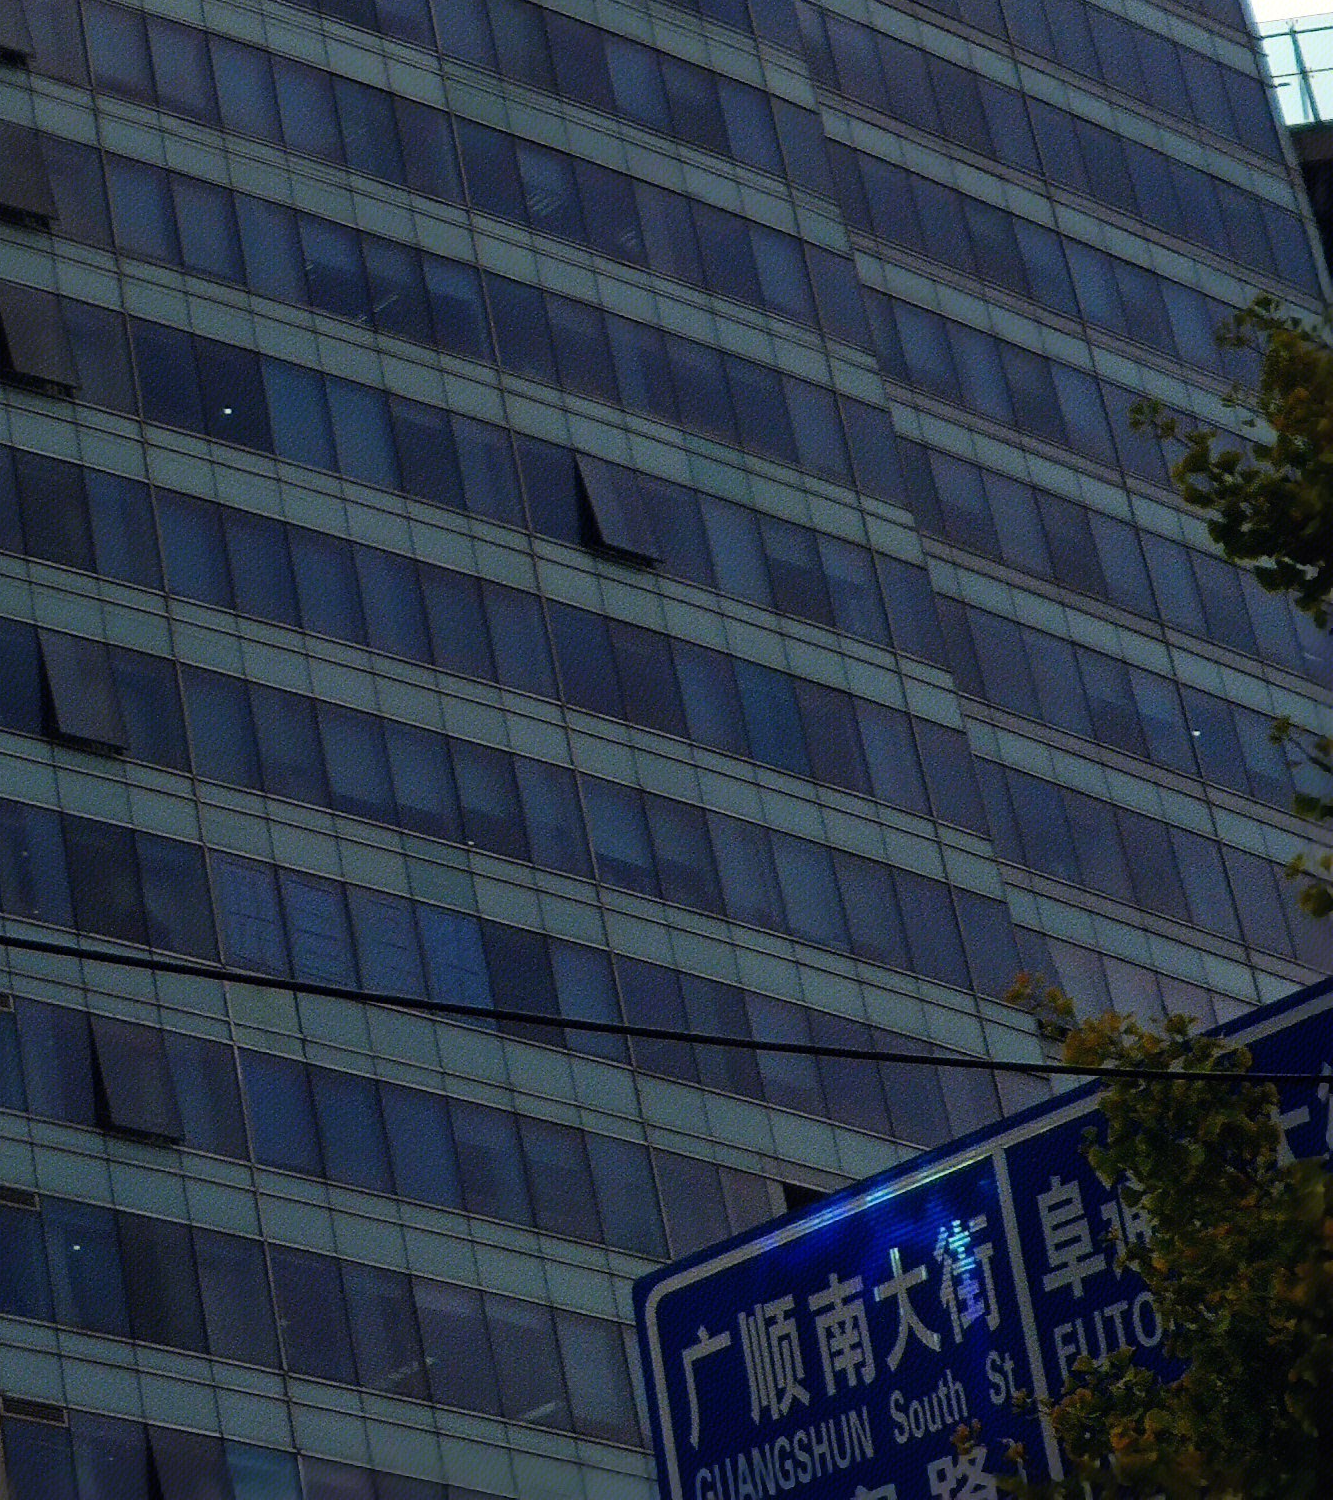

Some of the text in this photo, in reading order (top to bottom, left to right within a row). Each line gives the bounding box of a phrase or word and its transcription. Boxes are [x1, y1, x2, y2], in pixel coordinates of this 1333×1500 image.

[680, 1214, 1003, 1450] 广顺南大街
[694, 1406, 875, 1500] GUANGSHUN
[889, 1369, 968, 1444] South
[985, 1349, 1017, 1405] St
